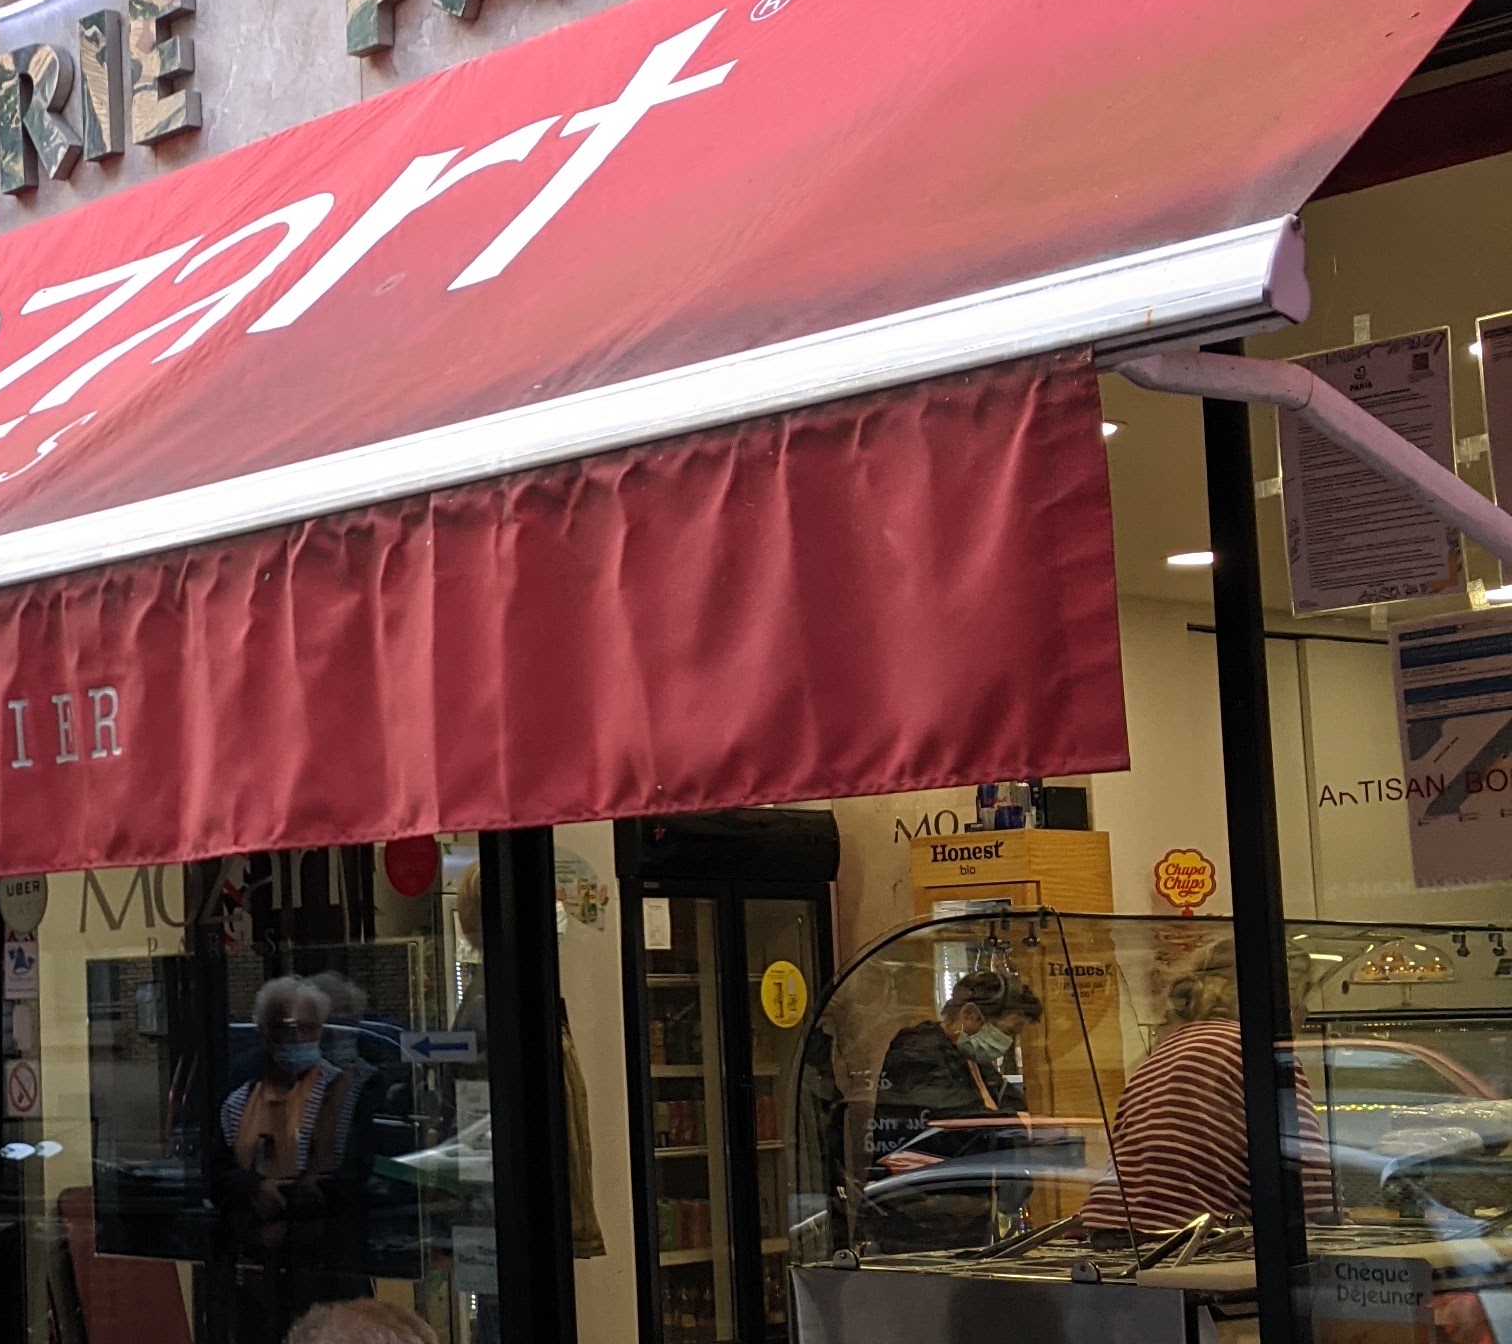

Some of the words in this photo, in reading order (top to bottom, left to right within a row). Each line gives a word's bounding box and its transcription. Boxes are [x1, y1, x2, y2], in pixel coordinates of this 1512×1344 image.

[1465, 768, 1512, 794] BO
[930, 840, 1004, 863] Honest
[959, 864, 976, 875] bio
[1165, 862, 1207, 878] Chupa
[6, 880, 40, 898] UBER
[1164, 875, 1206, 897] Chups
[1048, 962, 1113, 977] Honest
[1335, 1262, 1409, 1285] Chèque
[1337, 1284, 1424, 1307] Déjeuner
